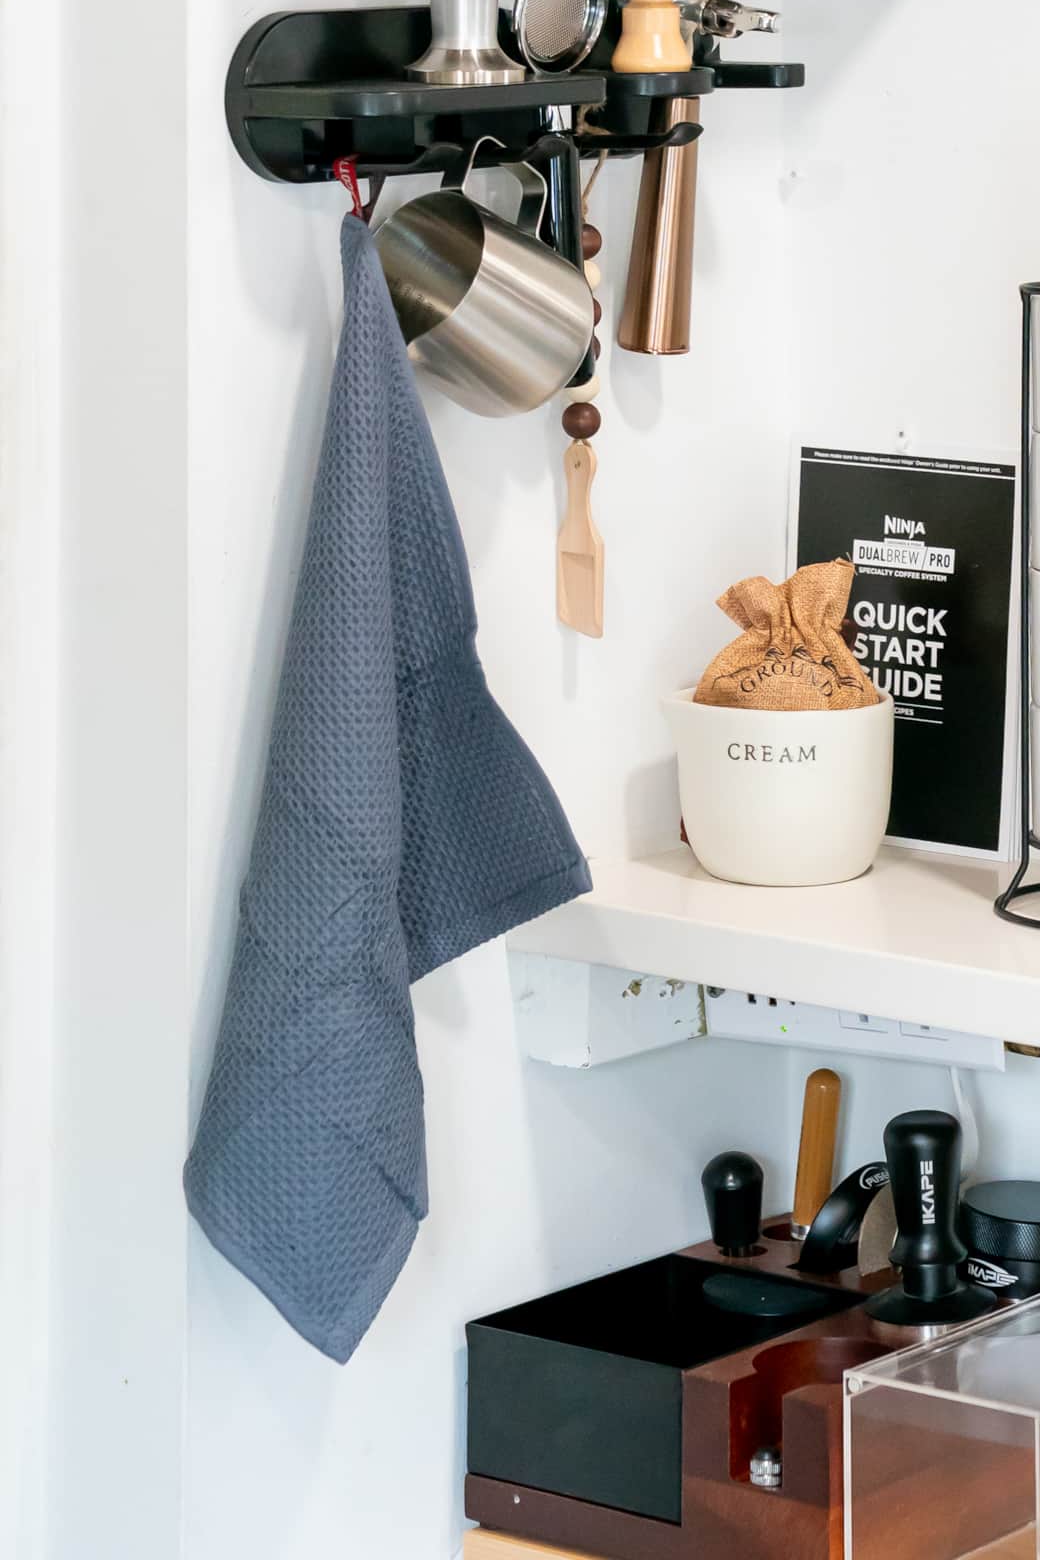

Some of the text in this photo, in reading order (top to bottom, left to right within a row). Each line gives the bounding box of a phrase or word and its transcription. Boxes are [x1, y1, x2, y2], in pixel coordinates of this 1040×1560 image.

[884, 514, 926, 539] NINJA
[859, 546, 951, 568] DUALBREW PRO
[859, 567, 948, 582] SPECIALTY COFFEE SYSTEM
[853, 600, 948, 637] QUICK
[853, 633, 945, 669] START
[727, 743, 817, 763] CREAM
[920, 1160, 936, 1225] IKAPE
